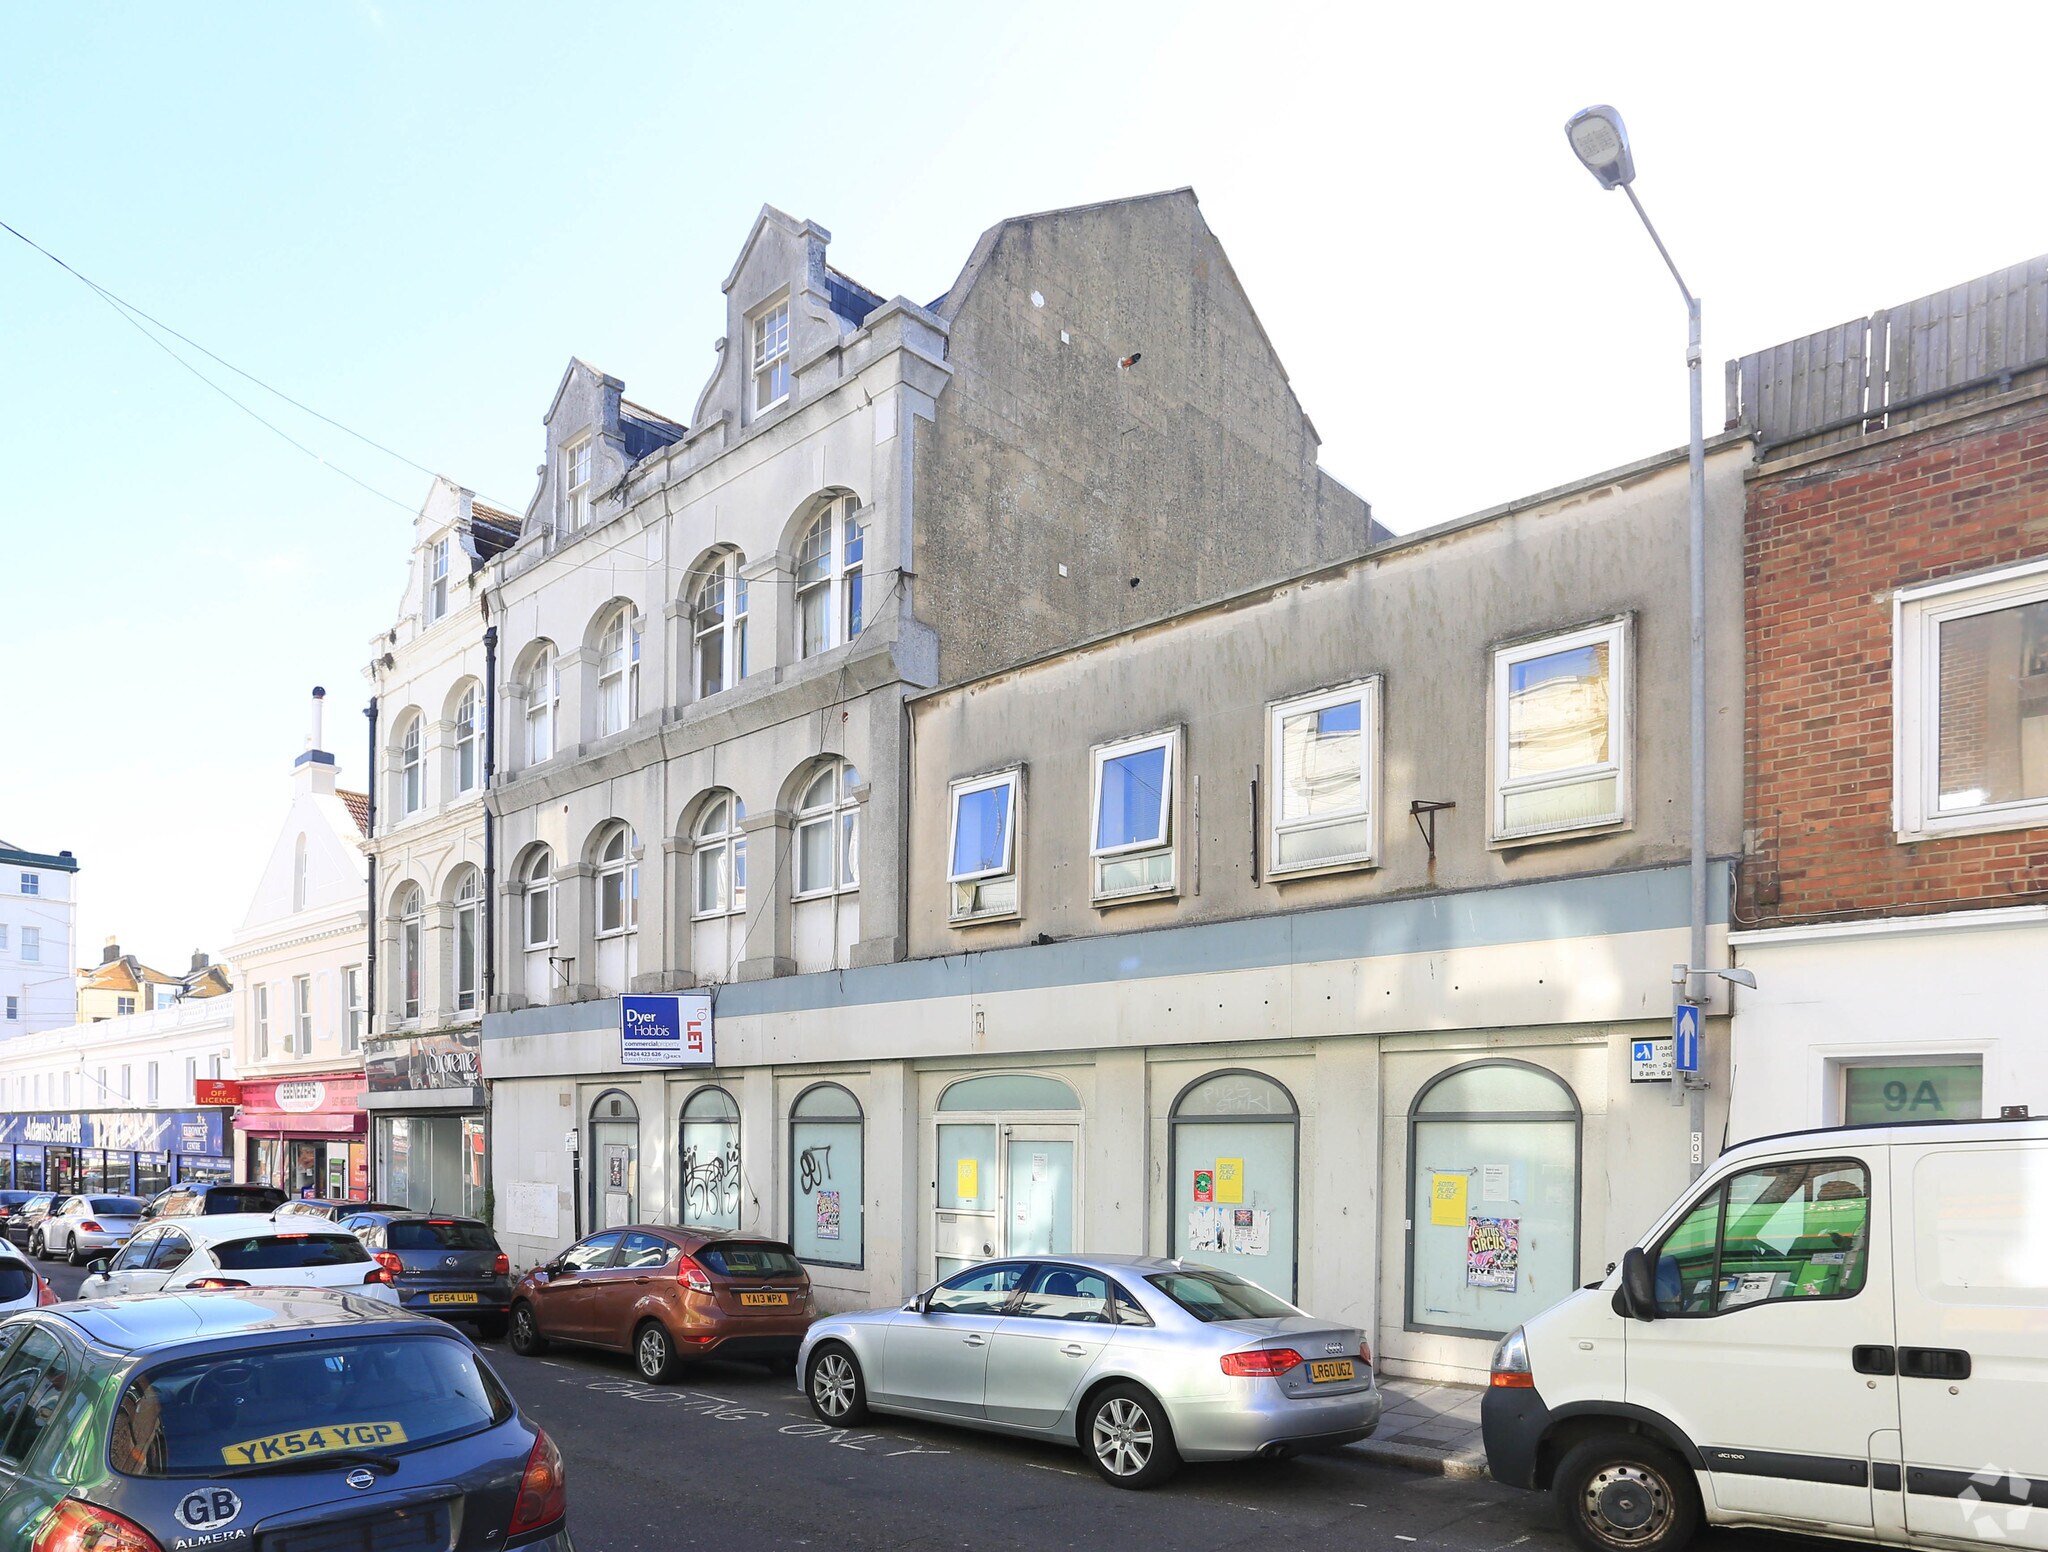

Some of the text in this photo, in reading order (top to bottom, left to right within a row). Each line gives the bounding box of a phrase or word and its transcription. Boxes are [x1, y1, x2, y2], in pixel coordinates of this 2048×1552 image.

[626, 1009, 656, 1024] Dyer
[634, 1025, 670, 1036] Hobbis
[687, 1022, 703, 1053] LET
[428, 1047, 478, 1079] Supreme
[1883, 1080, 1944, 1111] 9A
[1692, 1133, 1700, 1162] 505
[1475, 1227, 1500, 1238] SANTUS
[1472, 1236, 1506, 1254] CIRCUS
[1470, 1267, 1494, 1275] RYE
[433, 1294, 474, 1302] GF64 LUH
[746, 1294, 765, 1304] YA13
[1312, 1362, 1352, 1379] LR60 UGZ
[238, 1425, 392, 1463] YK54 YGP
[778, 1423, 950, 1457] ONLY
[183, 1490, 236, 1525] GB
[175, 1529, 247, 1551] ALMERA
